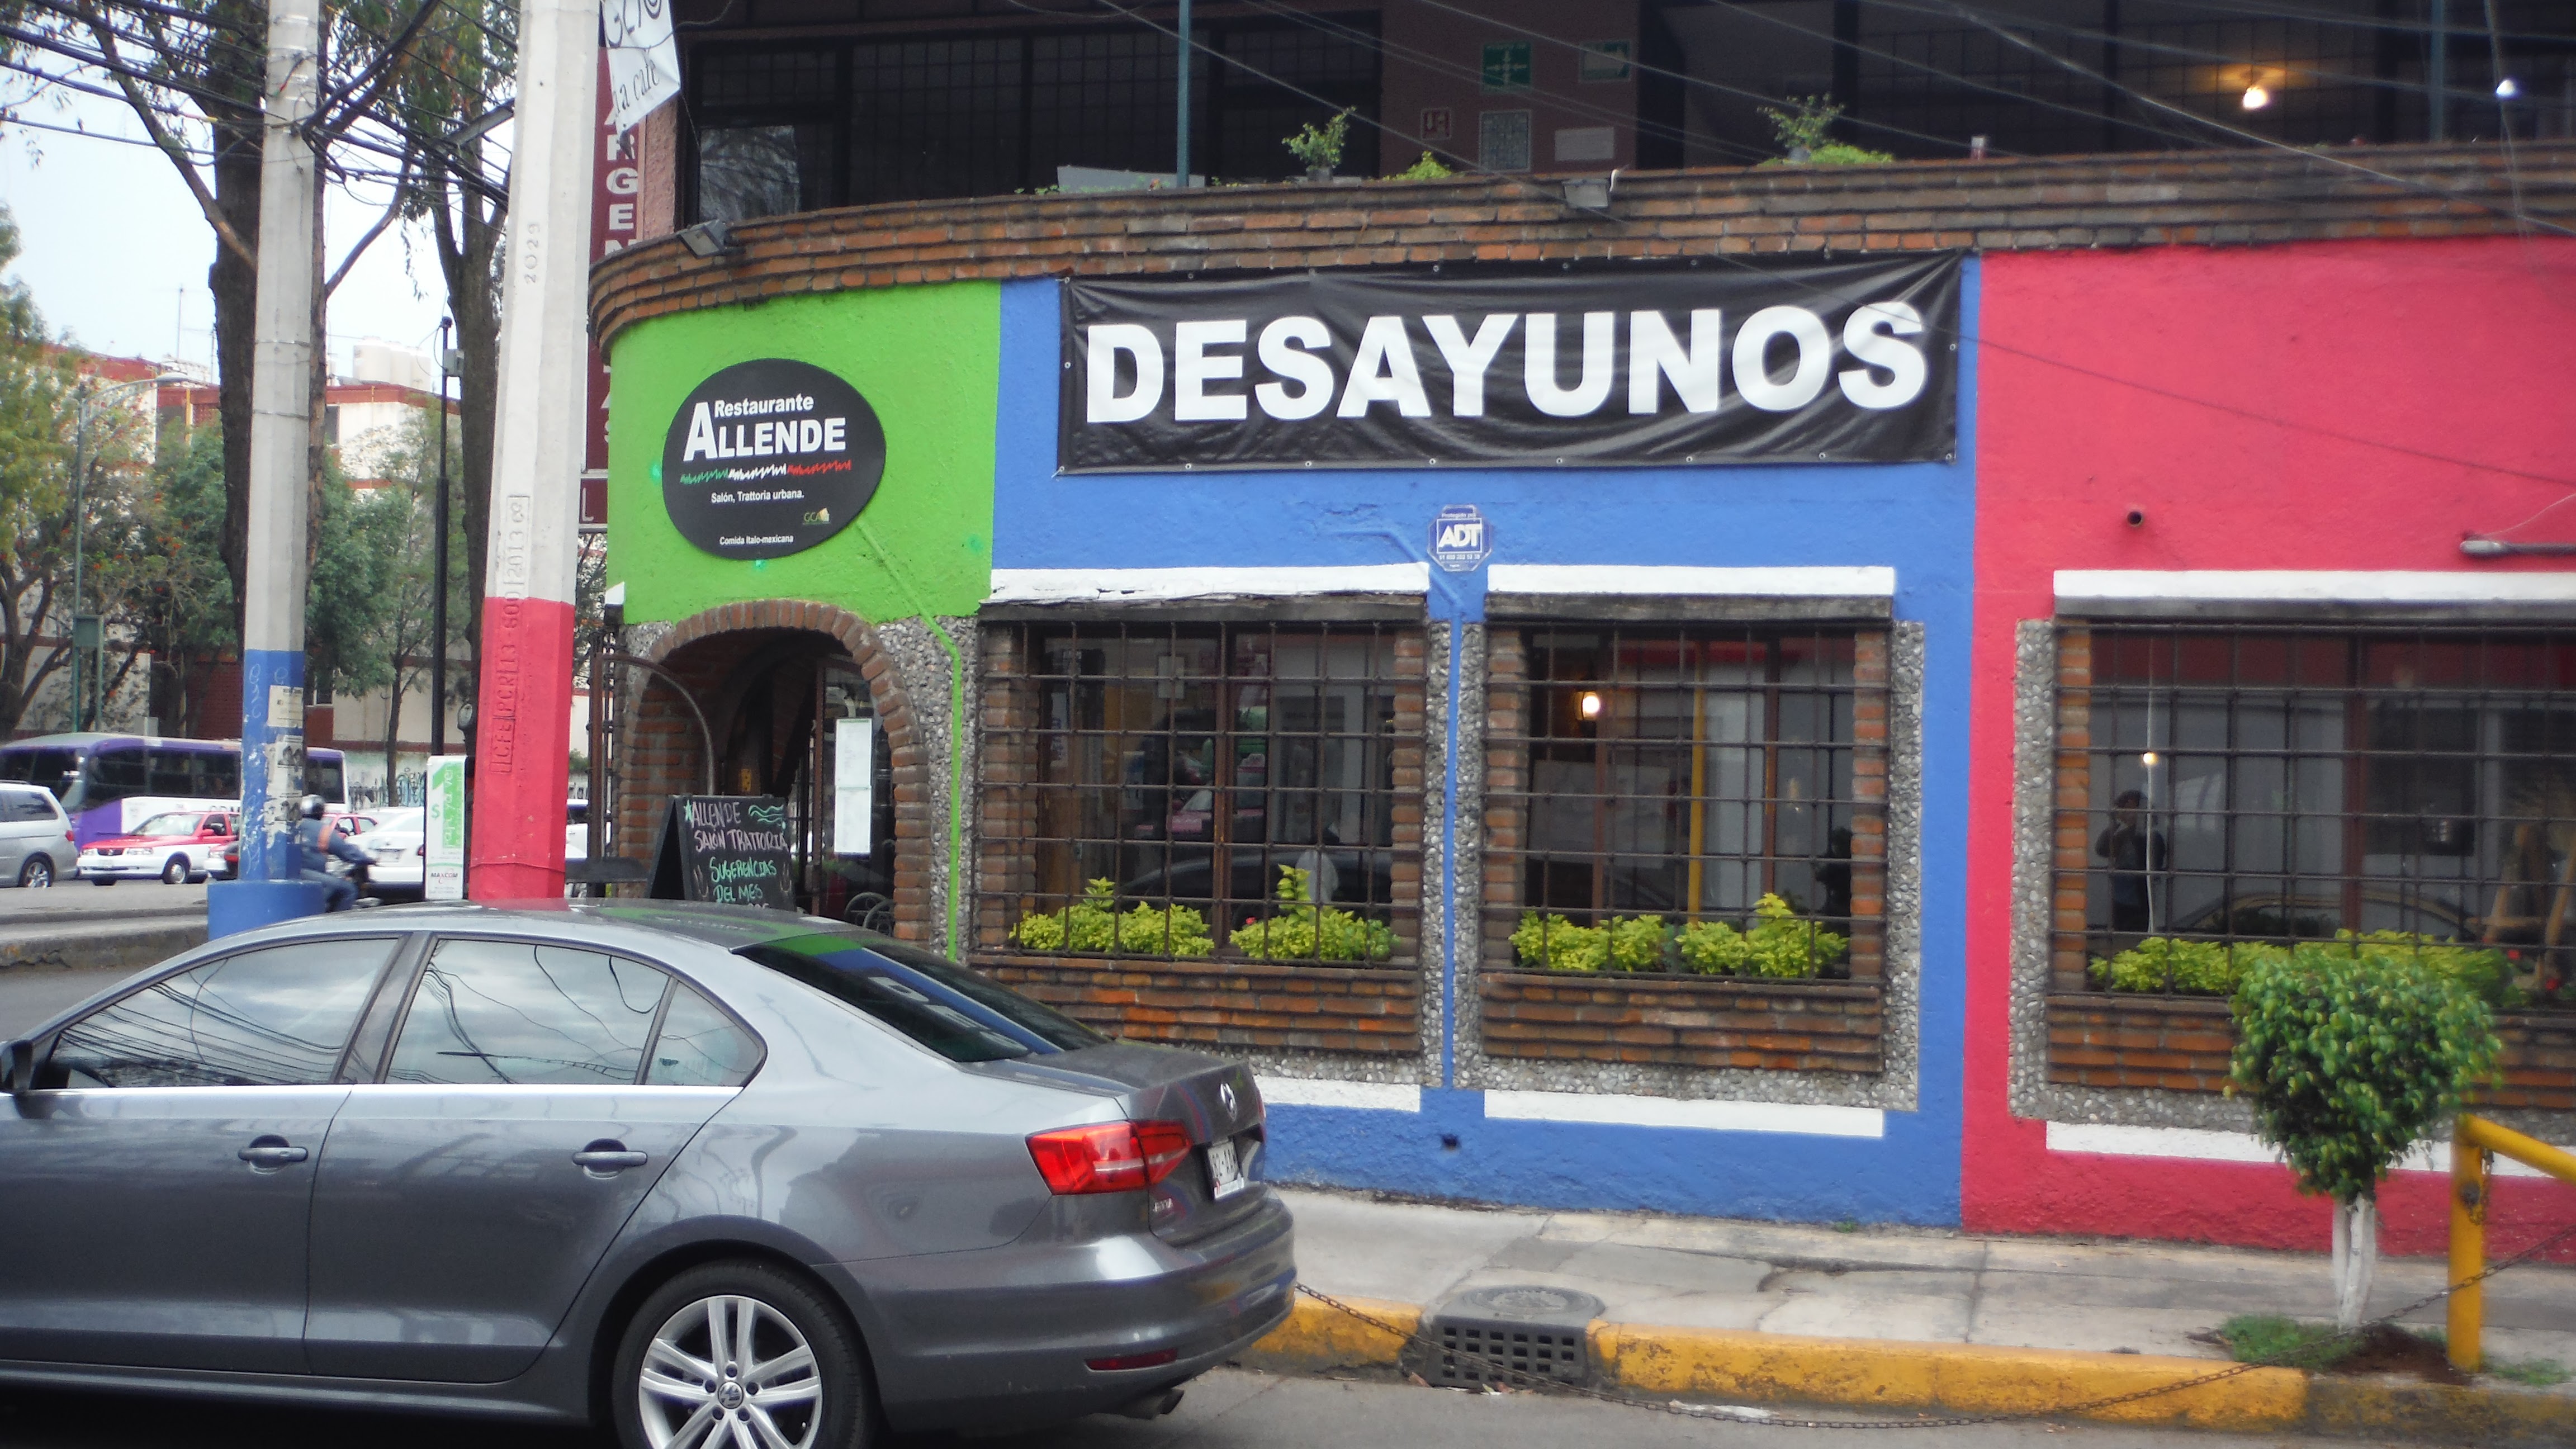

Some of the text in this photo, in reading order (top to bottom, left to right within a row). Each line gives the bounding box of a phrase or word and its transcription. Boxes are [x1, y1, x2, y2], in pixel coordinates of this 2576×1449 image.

[1086, 301, 1927, 423] DESAYUNOS
[714, 393, 814, 418] Restaurante
[683, 401, 846, 462] ALLENDE
[711, 489, 805, 504] Salón, Trattoria urbana.
[719, 536, 745, 546] Comida
[1438, 523, 1482, 547] ADT
[691, 801, 741, 828] ALLENDE
[727, 828, 790, 853] TRATTORIA
[709, 856, 777, 883] SUGERENCIAS
[713, 883, 763, 903] DEL MES
